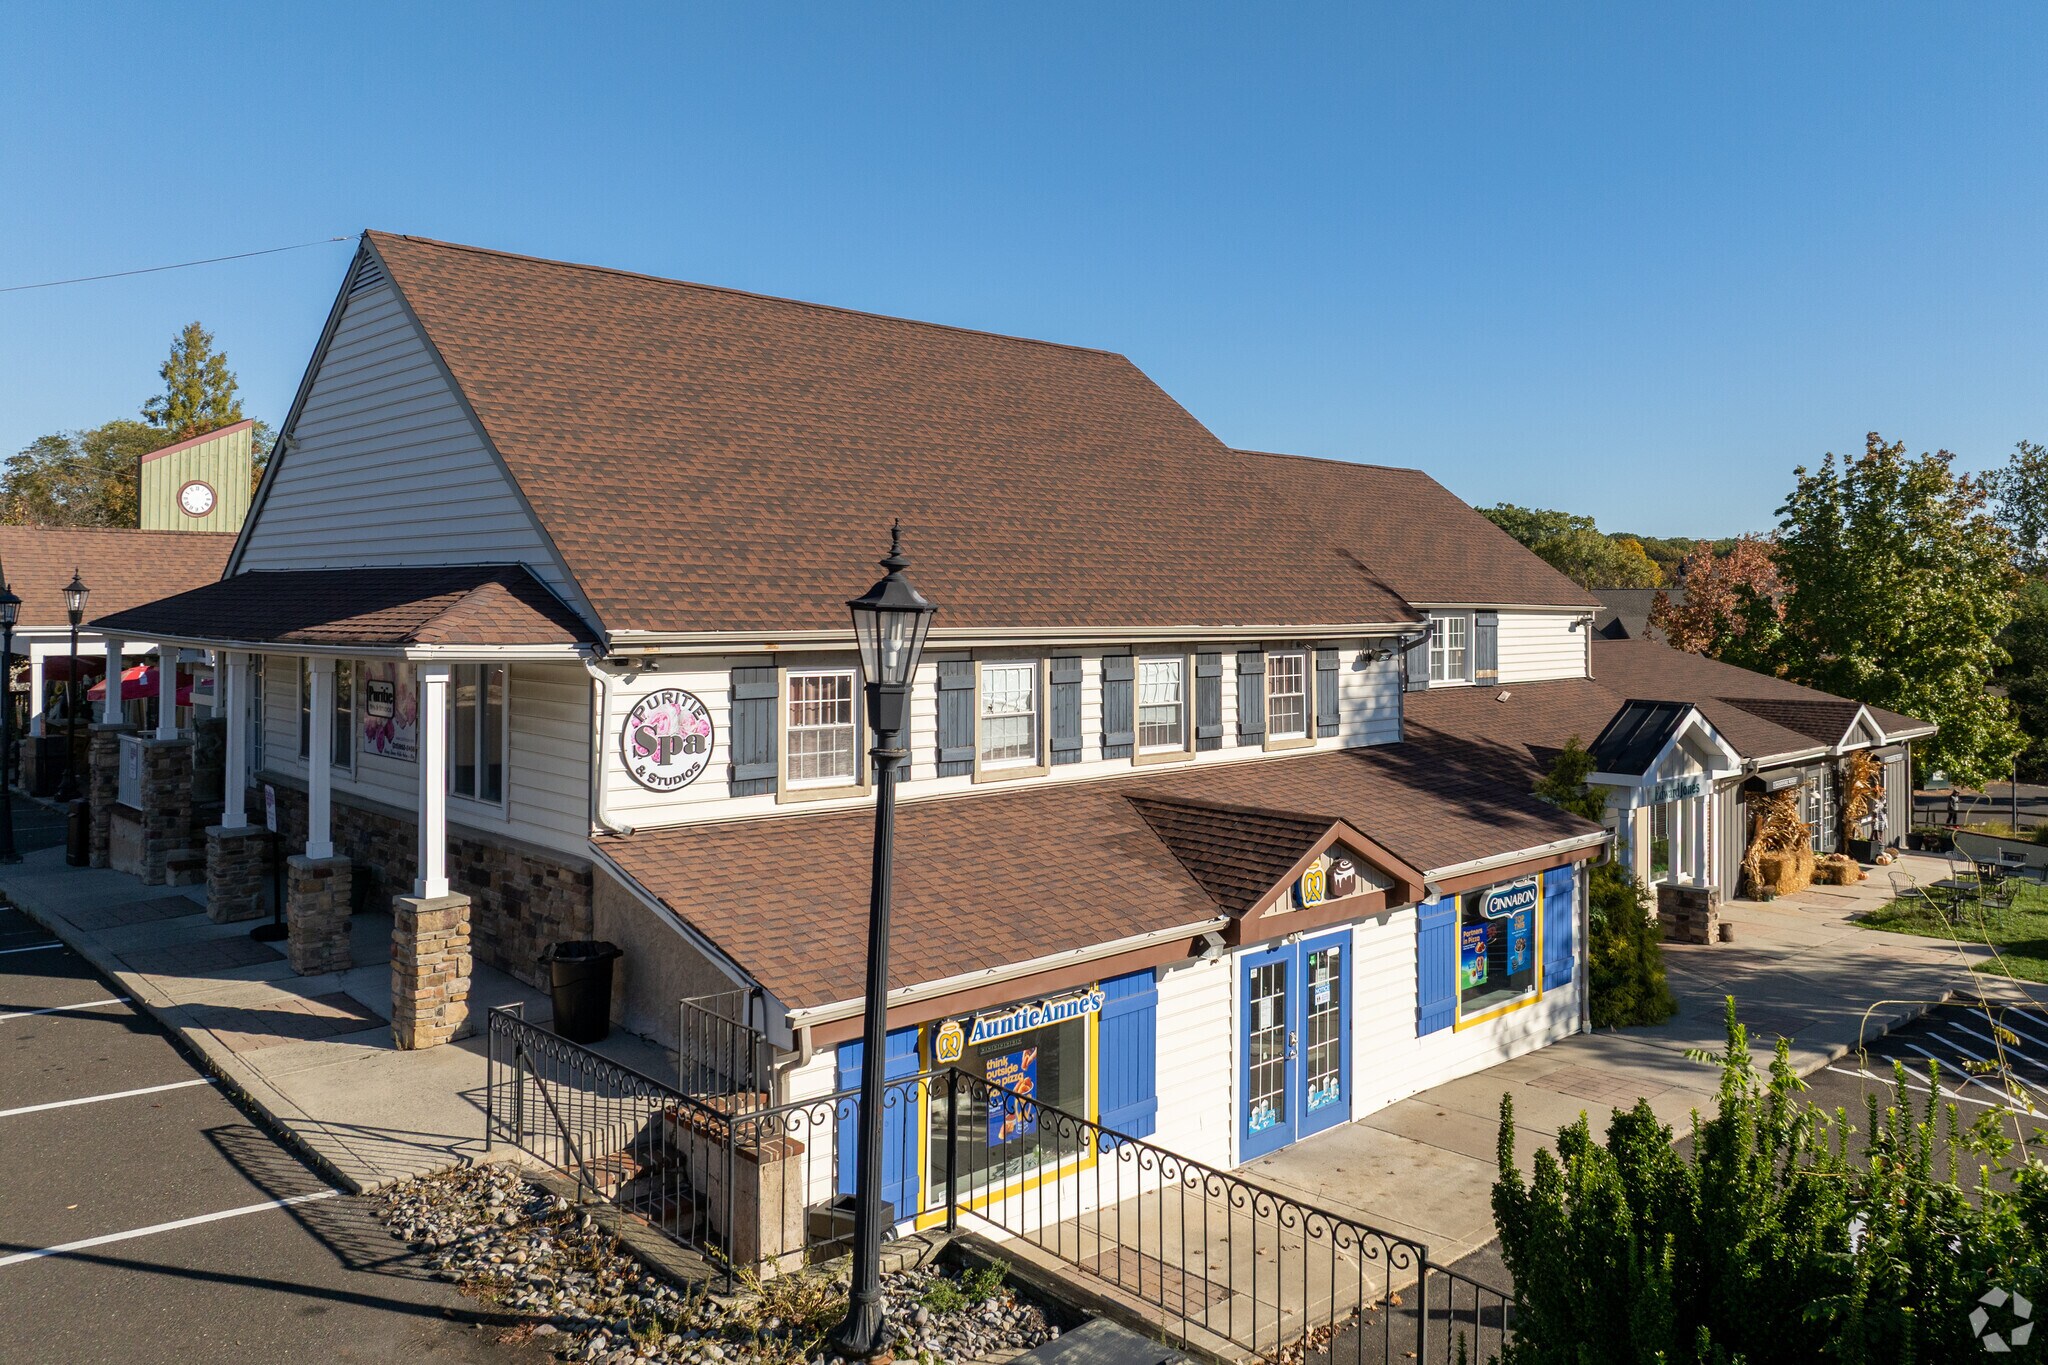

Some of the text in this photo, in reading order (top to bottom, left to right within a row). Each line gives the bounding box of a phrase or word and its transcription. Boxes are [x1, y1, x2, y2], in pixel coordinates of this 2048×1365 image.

[633, 692, 705, 722] PURITIE
[633, 724, 706, 766] Spa
[635, 761, 702, 787] & STUDIOS
[1490, 889, 1535, 913] CINNABON
[986, 1056, 1008, 1070] think
[986, 1063, 1018, 1080] outside
[1002, 1072, 1024, 1087] pizza
